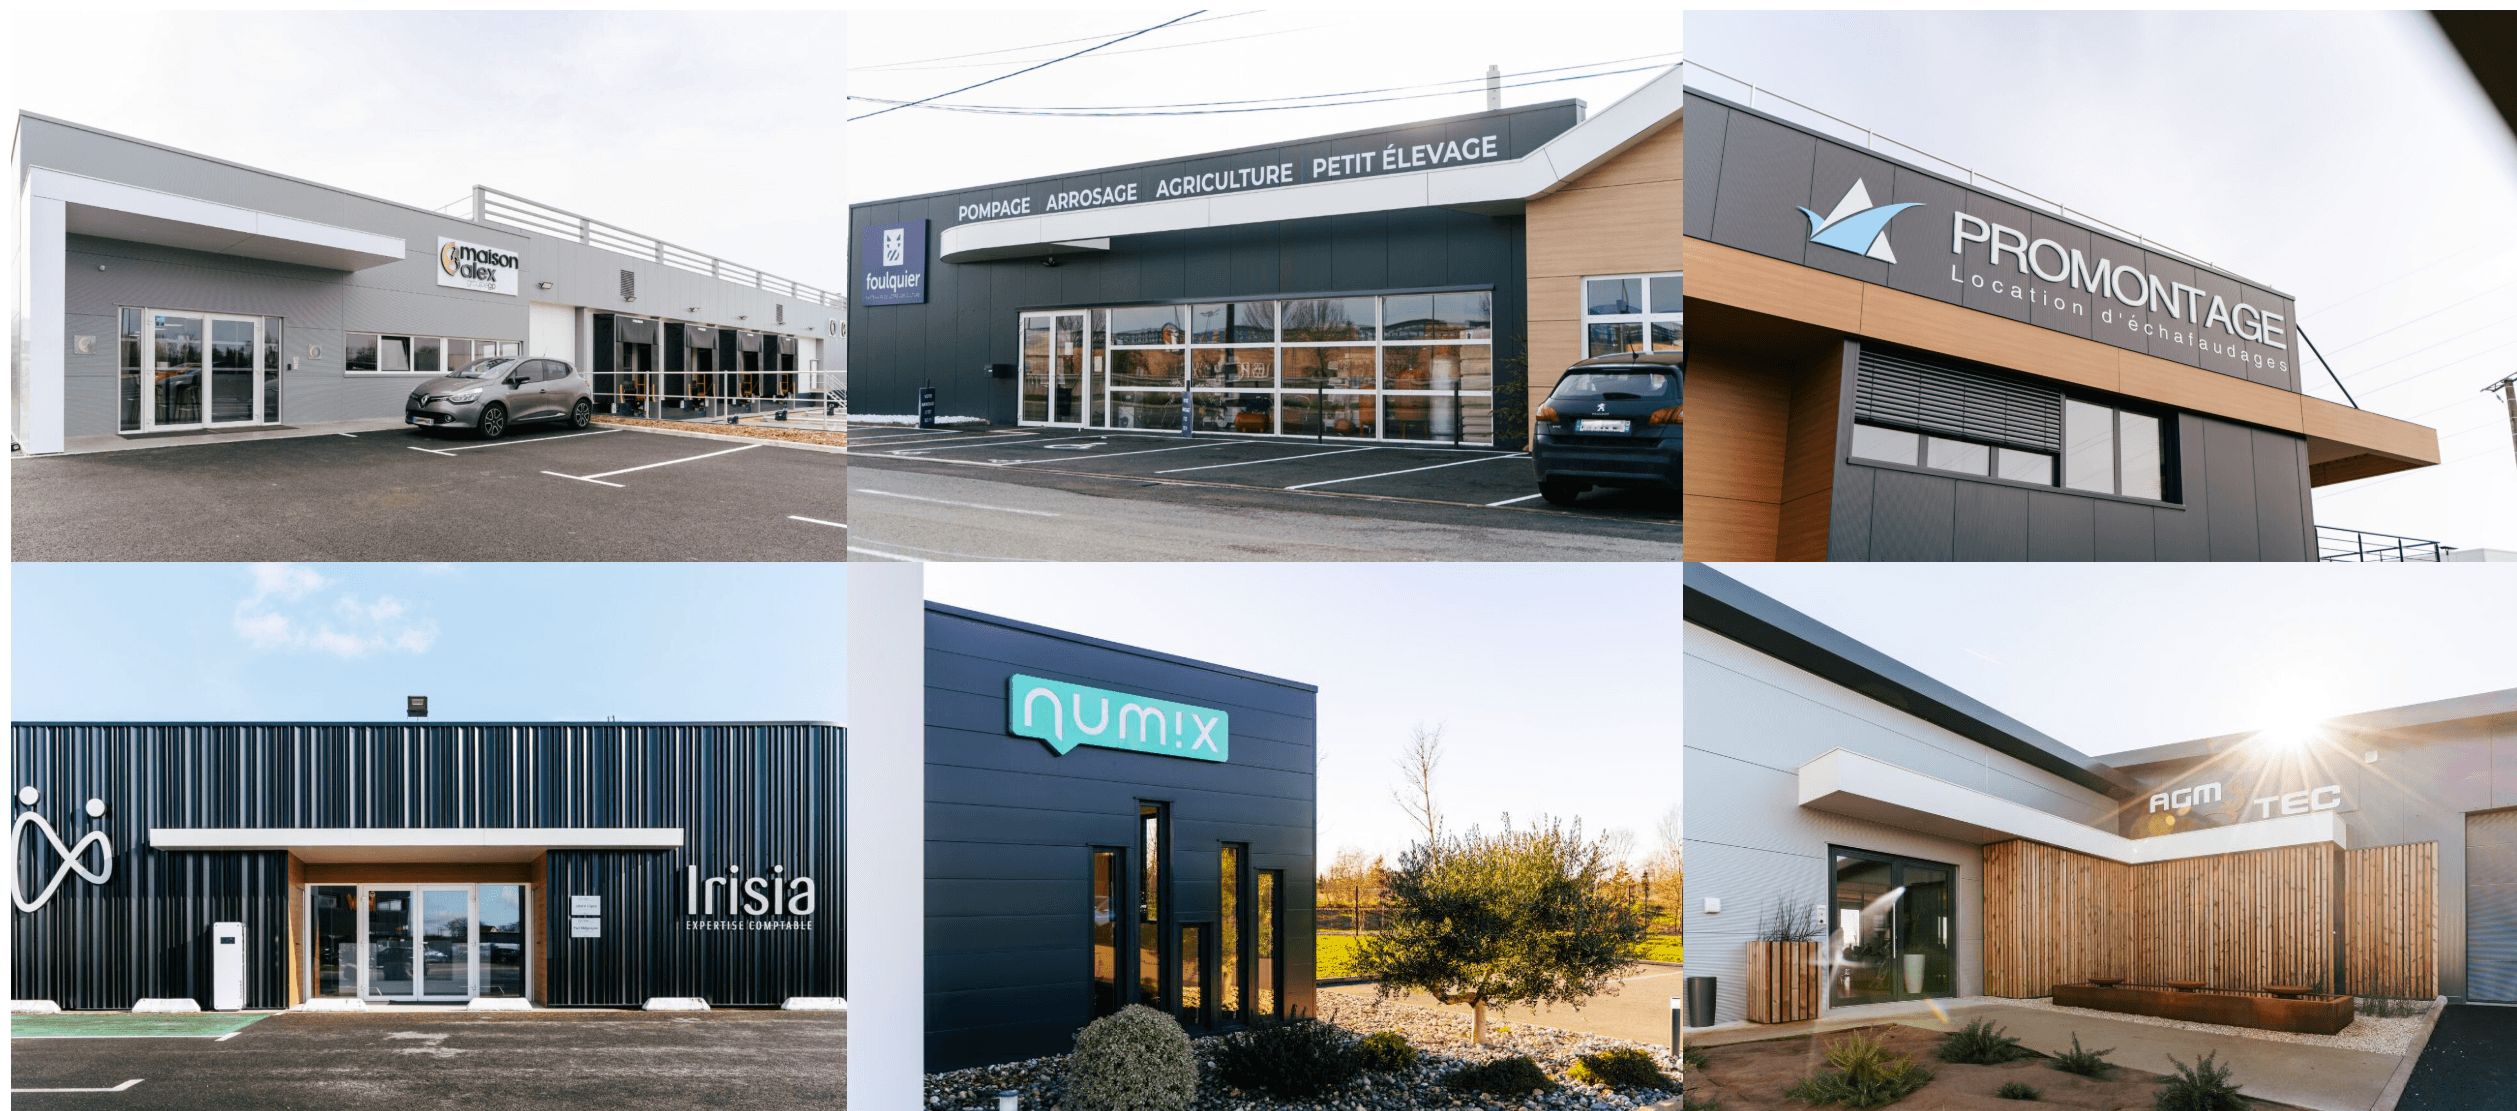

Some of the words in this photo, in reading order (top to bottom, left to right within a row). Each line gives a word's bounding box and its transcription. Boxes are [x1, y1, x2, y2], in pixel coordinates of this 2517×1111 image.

[958, 196, 1031, 222] POMPAGE
[1045, 183, 1138, 212] ARROSAGE
[1155, 162, 1293, 198] AGRICULTURE
[1312, 151, 1376, 178] PETIT
[1381, 134, 1498, 170] ÉLEVAGE
[460, 245, 519, 270] maison
[460, 261, 497, 282] alex
[866, 269, 921, 293] foulquier
[1952, 210, 2288, 350] PROMONTAGE
[1951, 264, 2084, 316] Location
[2101, 309, 2288, 372] d'échafaudages
[2150, 782, 2222, 813] AGM
[2253, 784, 2341, 819] TEC
[688, 864, 816, 916] Irisia
[686, 920, 744, 931] EXPERTISE
[749, 920, 813, 931] COMPTABLE
